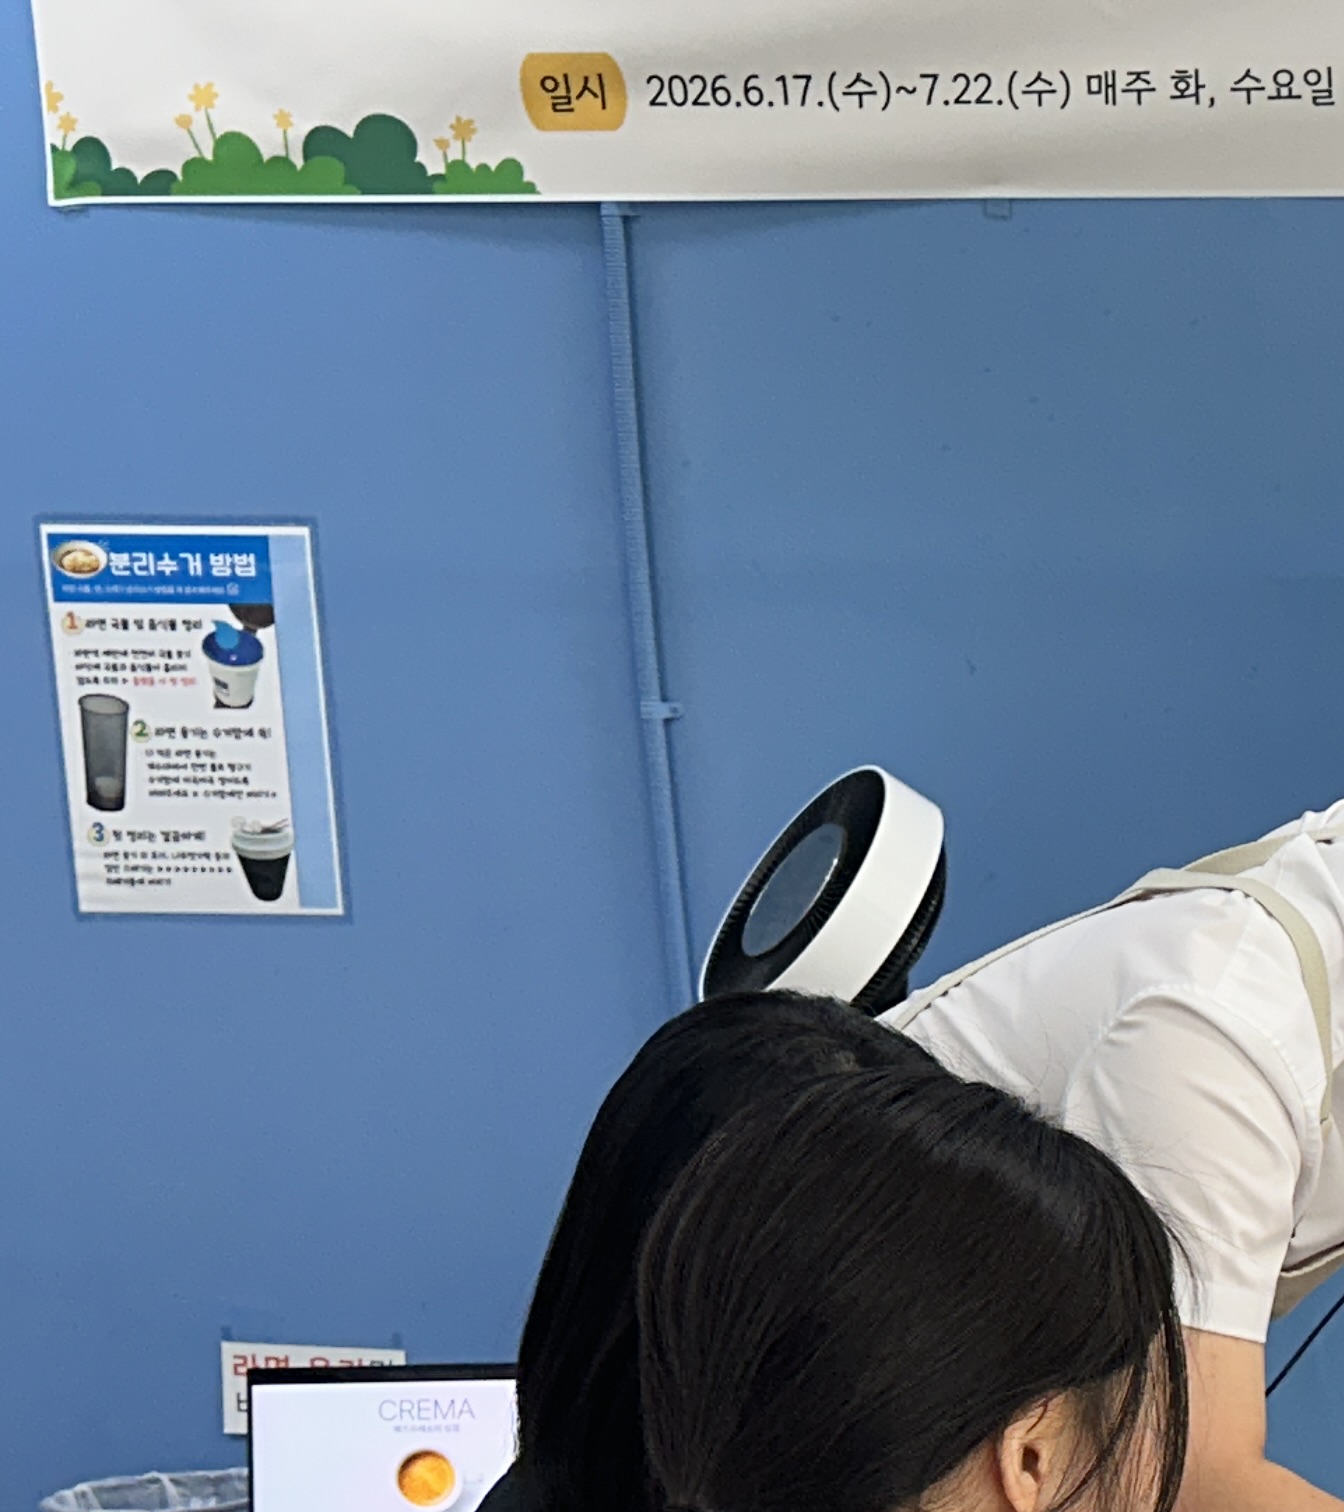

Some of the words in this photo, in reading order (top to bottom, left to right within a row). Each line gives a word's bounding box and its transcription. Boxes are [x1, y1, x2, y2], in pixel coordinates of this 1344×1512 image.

[539, 72, 607, 113] 일시
[646, 70, 1071, 112] 2026.6.17.(수)~7.22.(수)
[1086, 69, 1157, 106] 매주
[1169, 68, 1216, 108] 화,
[1230, 66, 1336, 107] 수요일
[108, 552, 202, 577] 분리수거
[209, 552, 256, 577] 방법
[132, 719, 149, 738] 2
[92, 821, 105, 843] 3
[378, 1398, 476, 1422] CREMA
